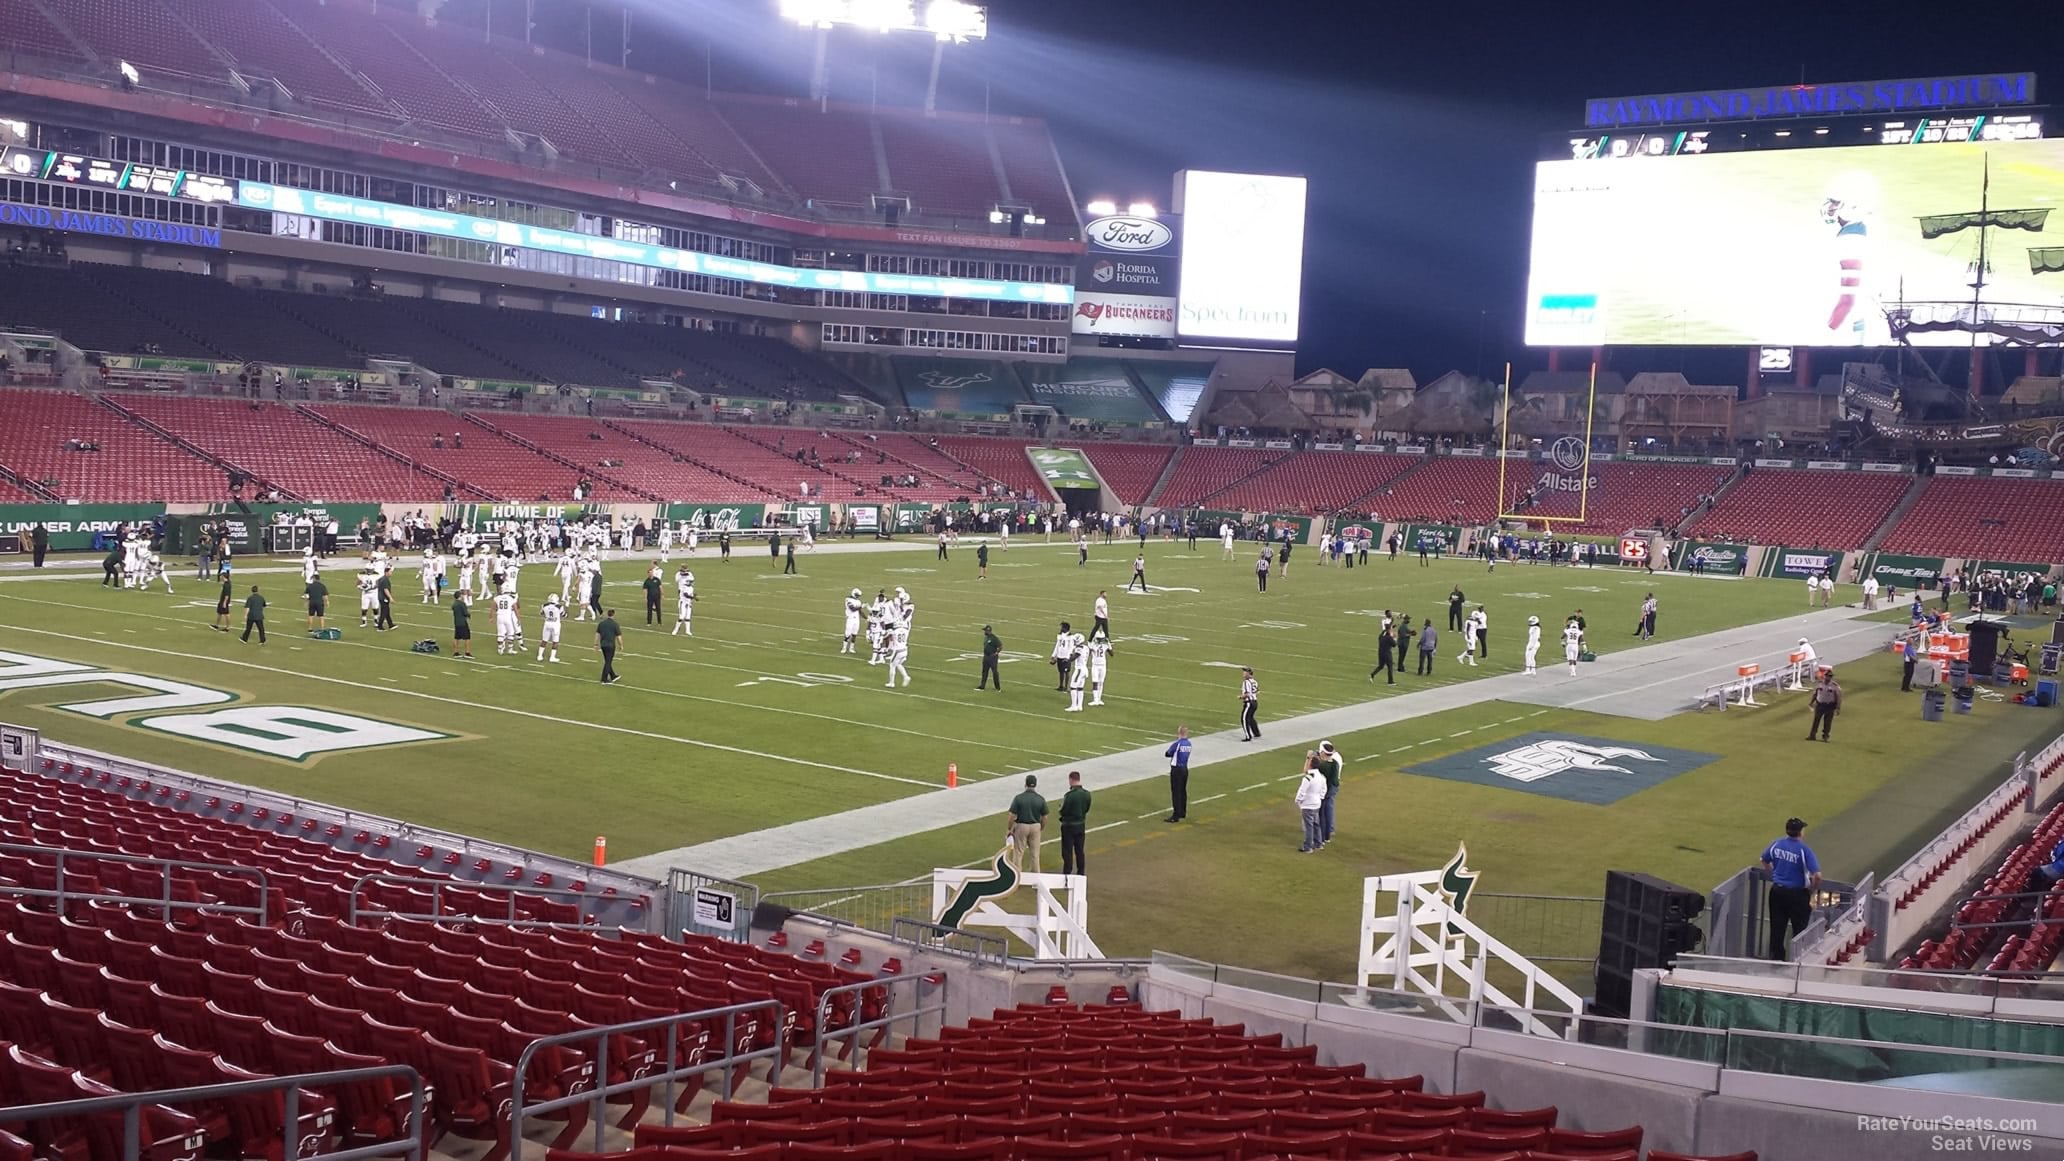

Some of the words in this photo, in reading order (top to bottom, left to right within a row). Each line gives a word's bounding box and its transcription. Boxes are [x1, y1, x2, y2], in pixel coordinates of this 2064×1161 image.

[1590, 92, 1750, 128] RAYMOND
[1754, 82, 1867, 117] JAMES
[1872, 74, 2029, 109] STADIUM
[55, 211, 127, 237] JAMES
[132, 221, 220, 248] STADIUM
[1103, 221, 1155, 246] Ford
[897, 232, 920, 241] TEXT
[923, 234, 940, 242] FAN
[944, 236, 976, 245] ISSUES
[1116, 262, 1156, 274] FLORIDA
[1116, 272, 1161, 284] HOSPITAL
[1105, 304, 1173, 323] BUCCANEERS
[1538, 472, 1597, 492] Allstate
[491, 506, 539, 518] HOME
[546, 506, 566, 518] OF
[1625, 540, 1645, 556] 25
[1787, 557, 1823, 566] TOWE
[499, 600, 509, 610] 68
[1774, 848, 1800, 864] SENTRY
